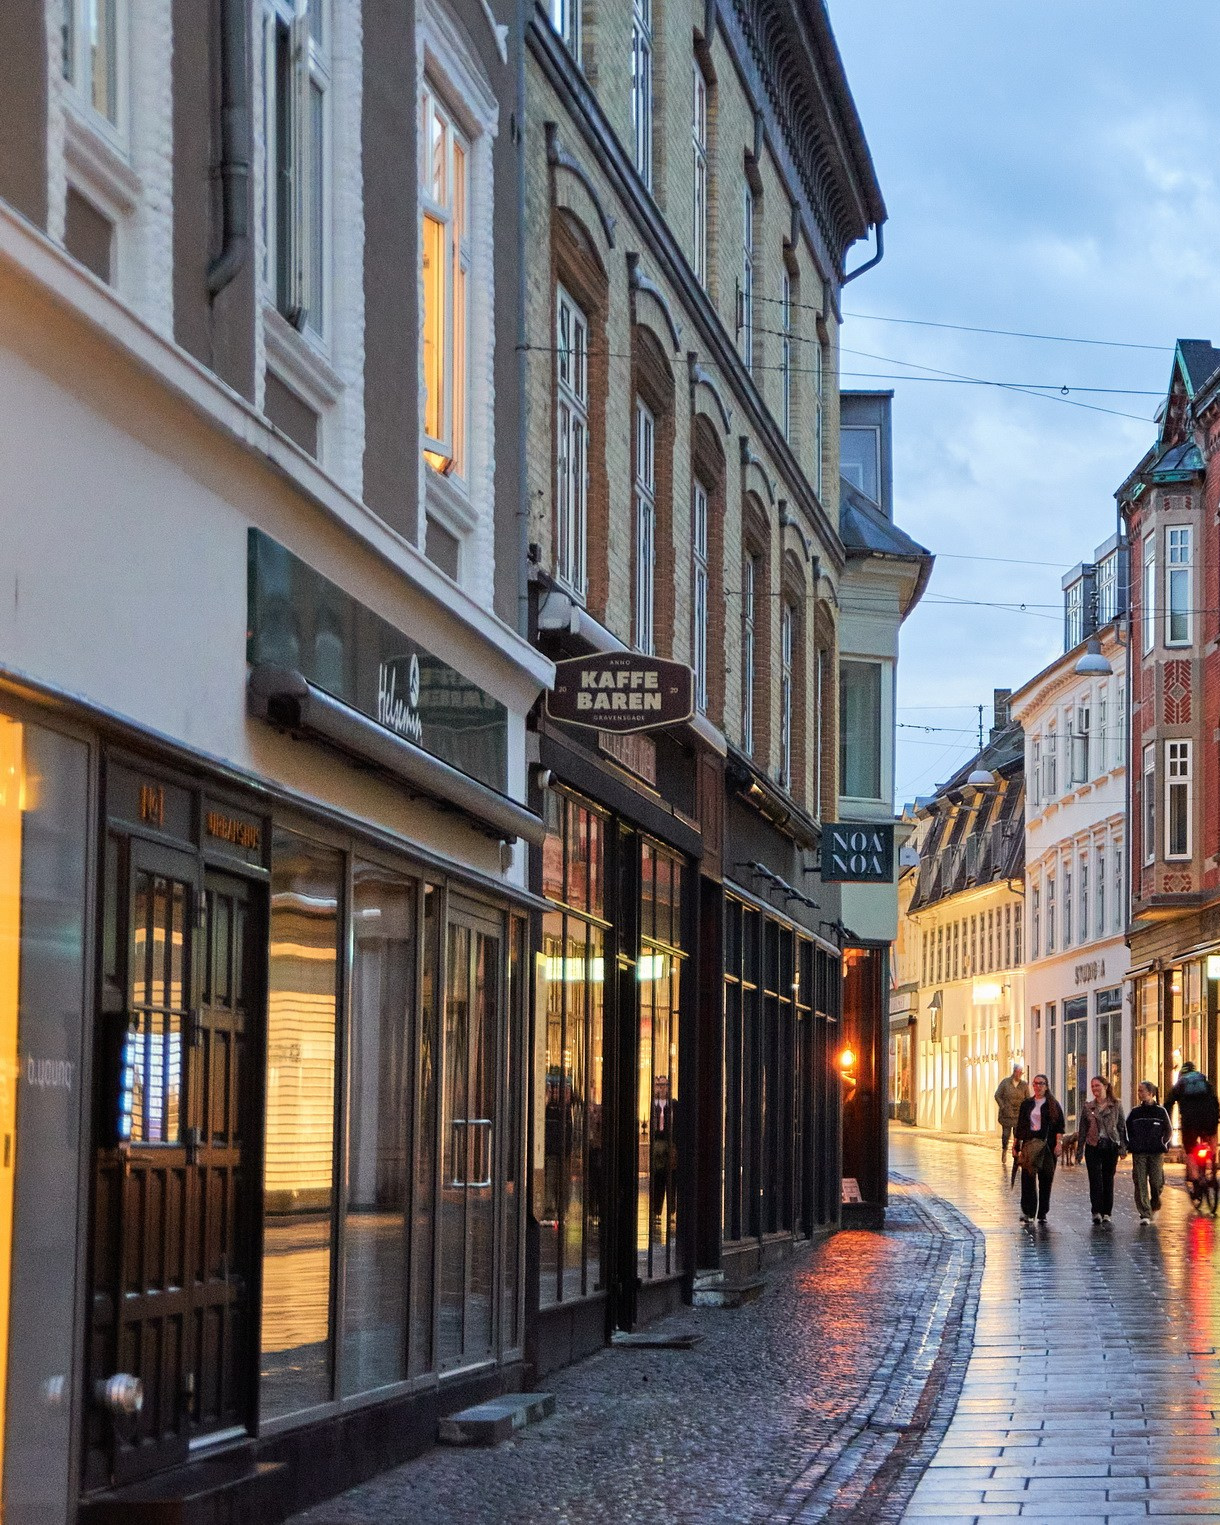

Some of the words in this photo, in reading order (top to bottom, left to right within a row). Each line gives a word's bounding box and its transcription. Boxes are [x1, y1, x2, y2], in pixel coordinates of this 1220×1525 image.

[581, 671, 659, 689] KAFFE
[577, 692, 662, 710] BAREN
[832, 832, 883, 852] NOA
[831, 854, 883, 874] NOA
